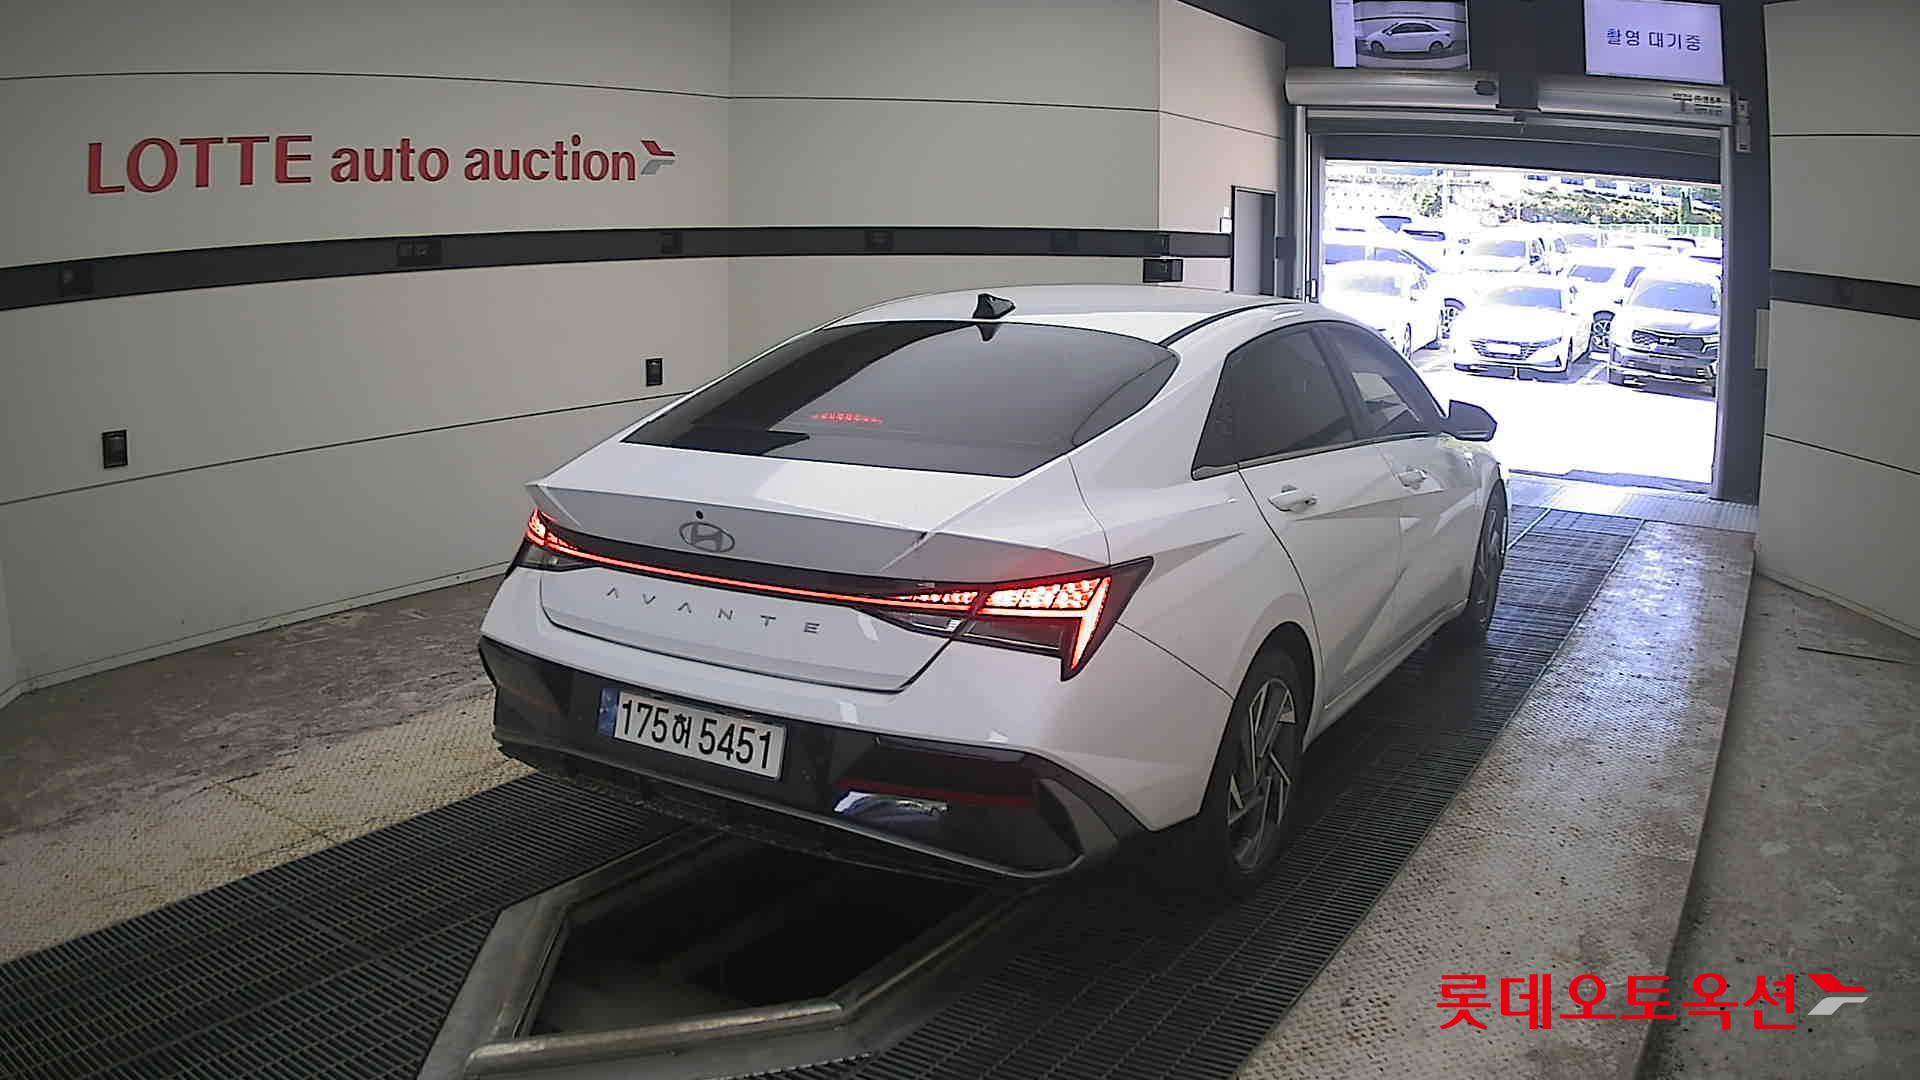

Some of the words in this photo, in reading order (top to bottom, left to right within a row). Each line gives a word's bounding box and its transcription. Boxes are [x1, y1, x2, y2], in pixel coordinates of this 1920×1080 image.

[1607, 28, 1640, 46] 촬영
[1648, 31, 1701, 51] 대기중
[87, 134, 313, 194] LOTTE
[331, 136, 450, 182] auto
[464, 133, 637, 182] auction
[606, 586, 820, 632] AVANTE
[622, 699, 693, 749] 175허
[698, 717, 772, 769] 5451
